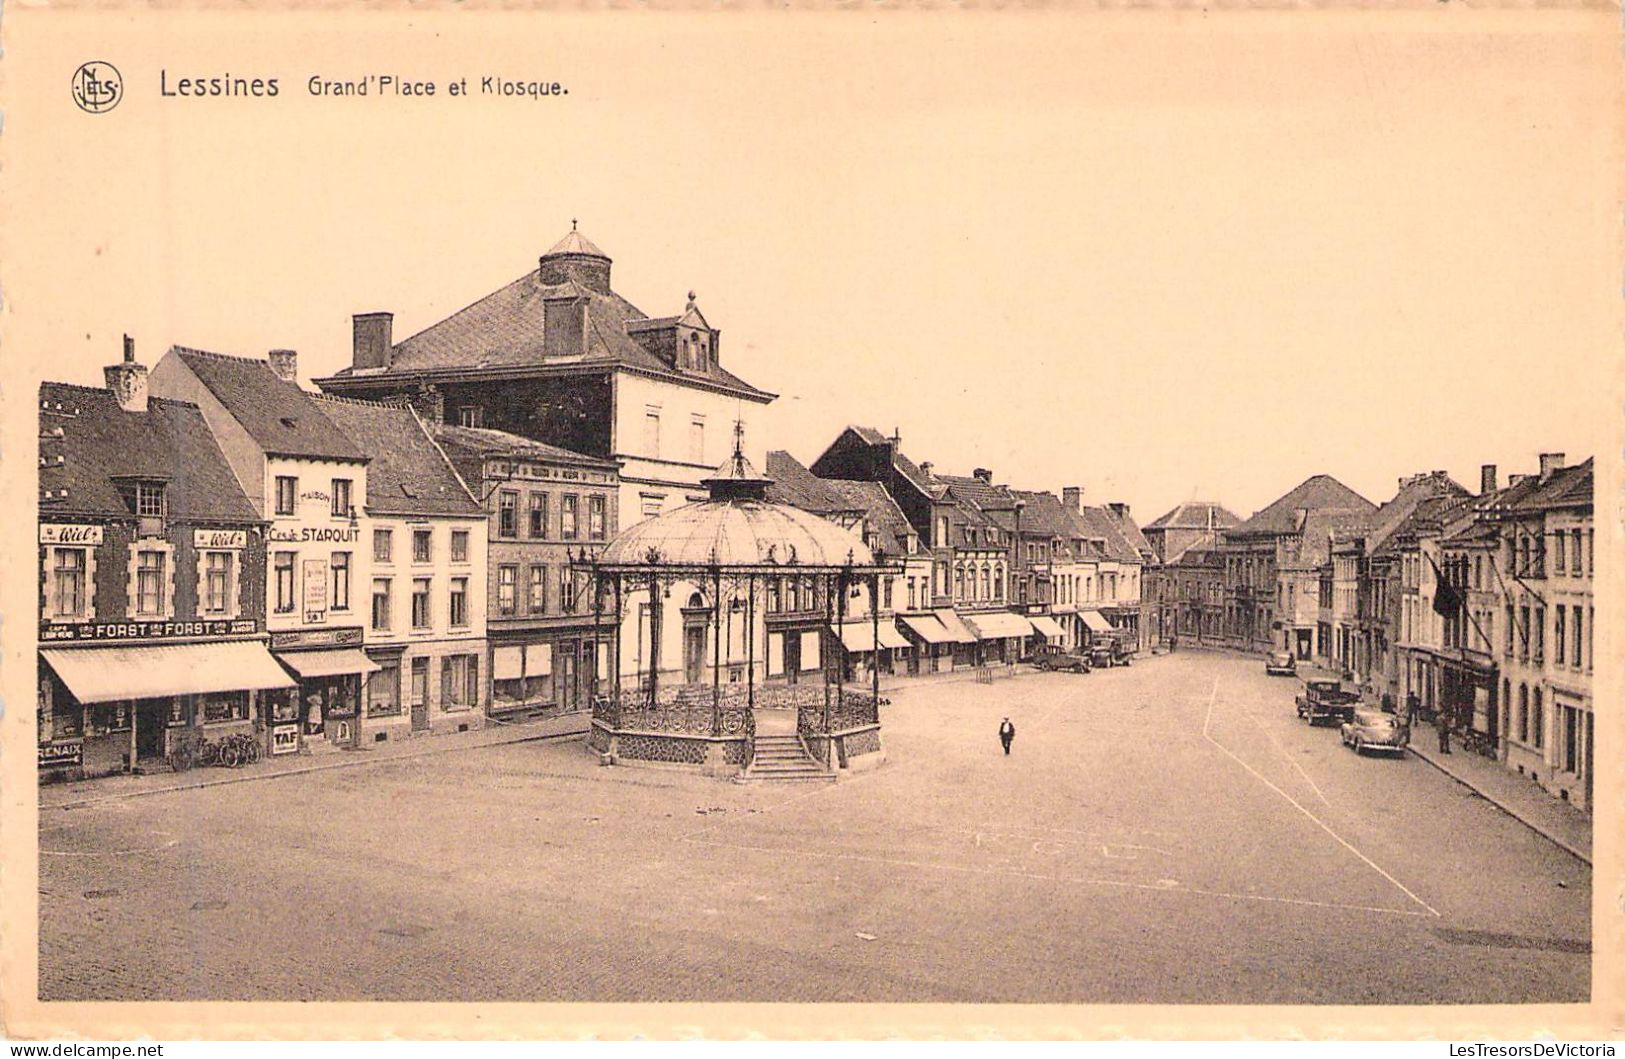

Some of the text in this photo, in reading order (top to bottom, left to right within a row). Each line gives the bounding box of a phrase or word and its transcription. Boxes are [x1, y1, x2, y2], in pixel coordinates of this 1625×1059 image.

[301, 528, 361, 542] STARQUIT
[96, 624, 148, 638] FORST
[165, 621, 213, 635] FORST
[274, 731, 297, 746] TAF
